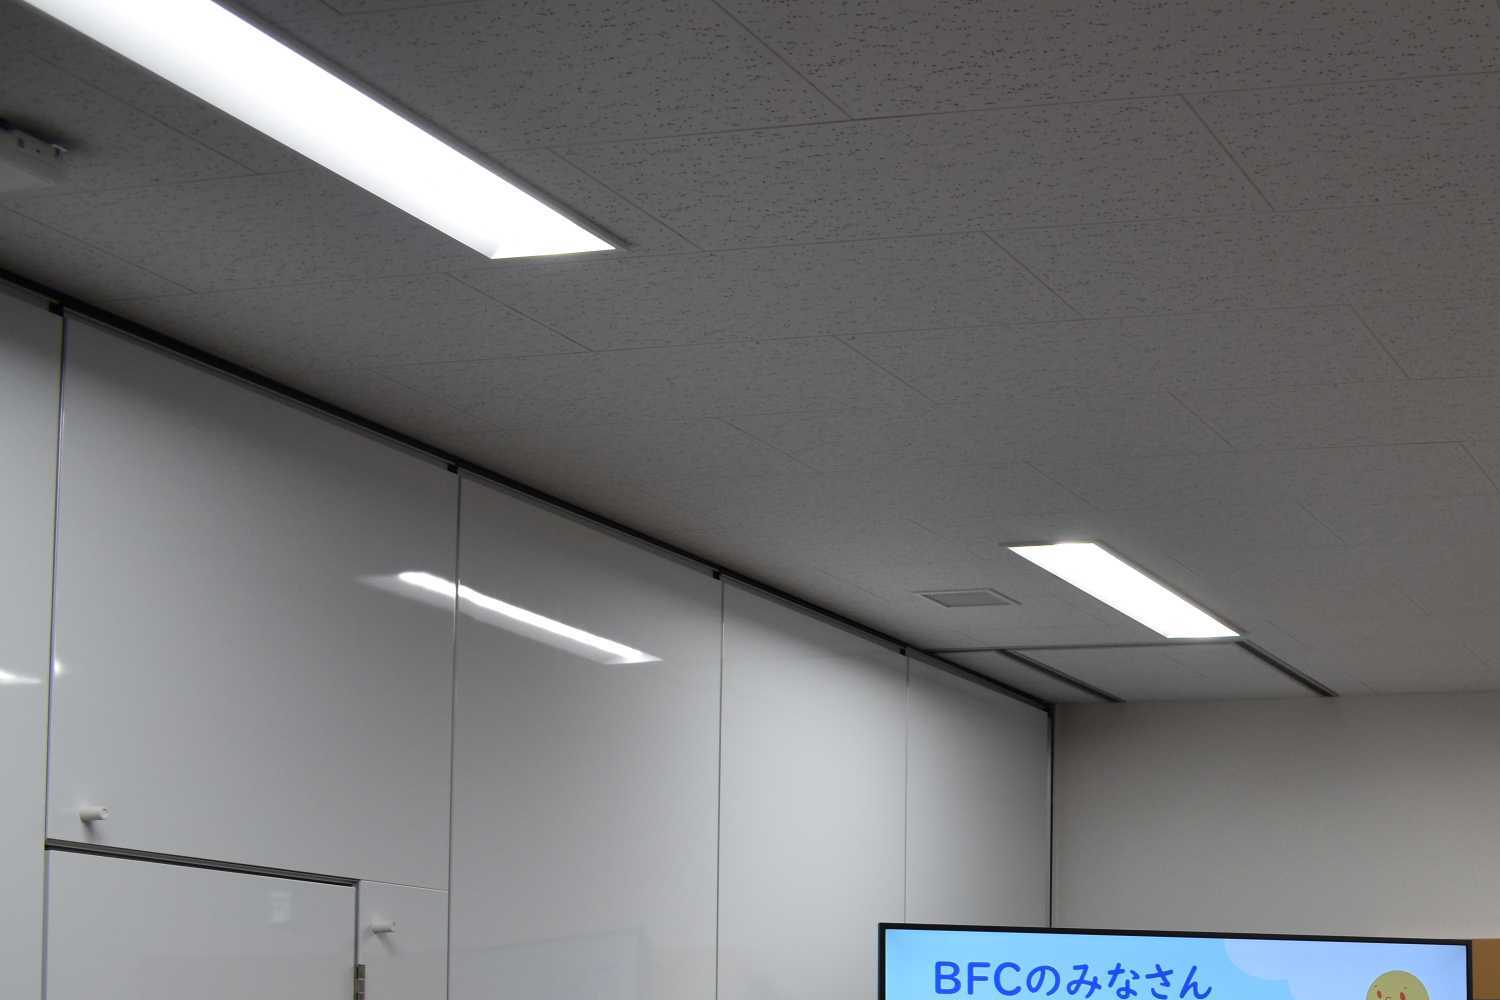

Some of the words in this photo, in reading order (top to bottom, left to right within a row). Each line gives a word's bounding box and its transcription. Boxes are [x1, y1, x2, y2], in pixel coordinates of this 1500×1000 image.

[934, 960, 1213, 1000] BFCのみなさん
